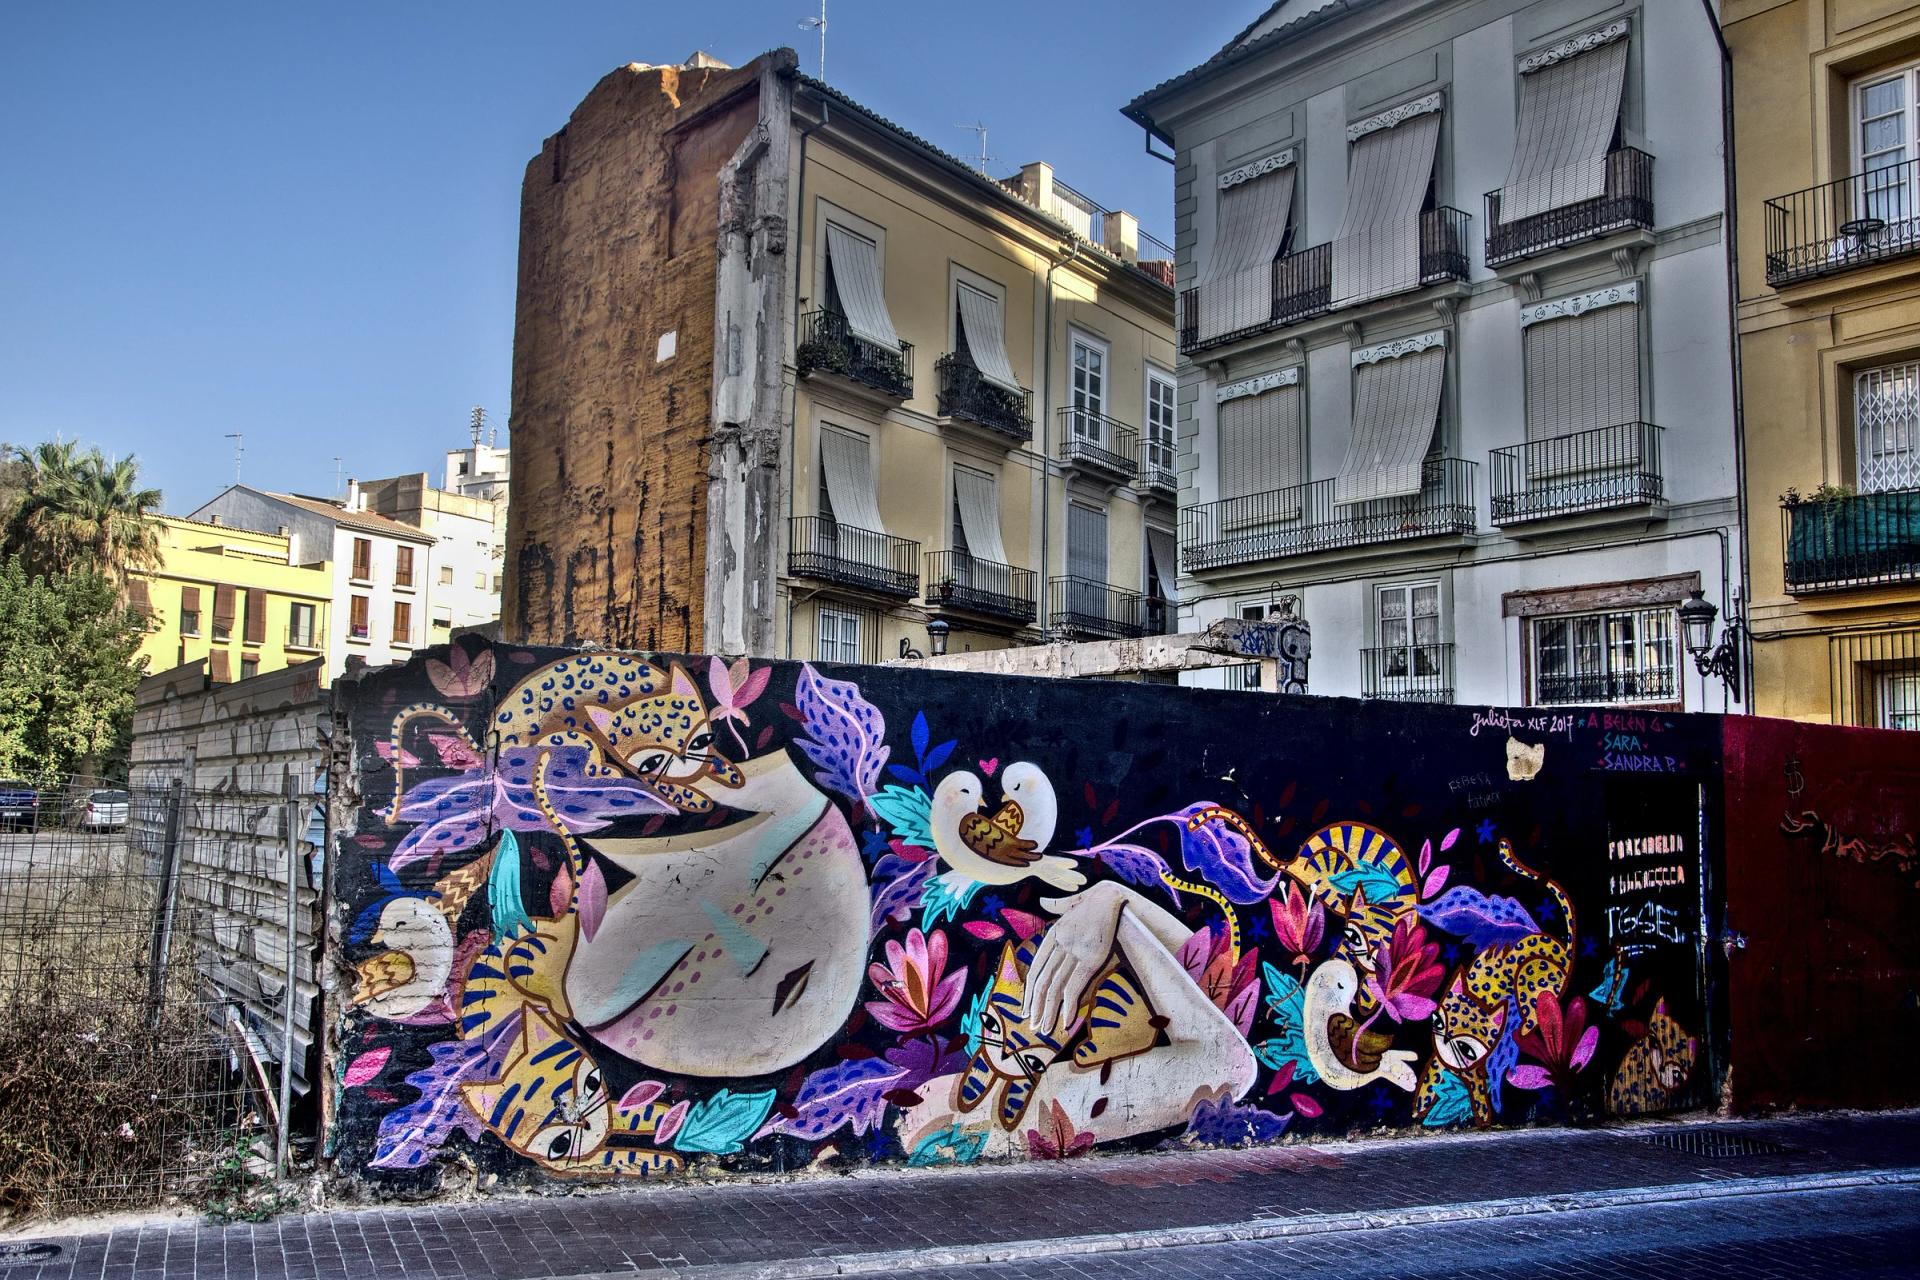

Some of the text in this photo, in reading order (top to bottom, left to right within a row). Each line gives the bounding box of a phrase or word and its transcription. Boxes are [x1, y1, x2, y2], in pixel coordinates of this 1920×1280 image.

[1470, 708, 1574, 742] Julieta XLF 2017
[1603, 731, 1642, 751] SARA
[1603, 751, 1663, 771] SANDRA
